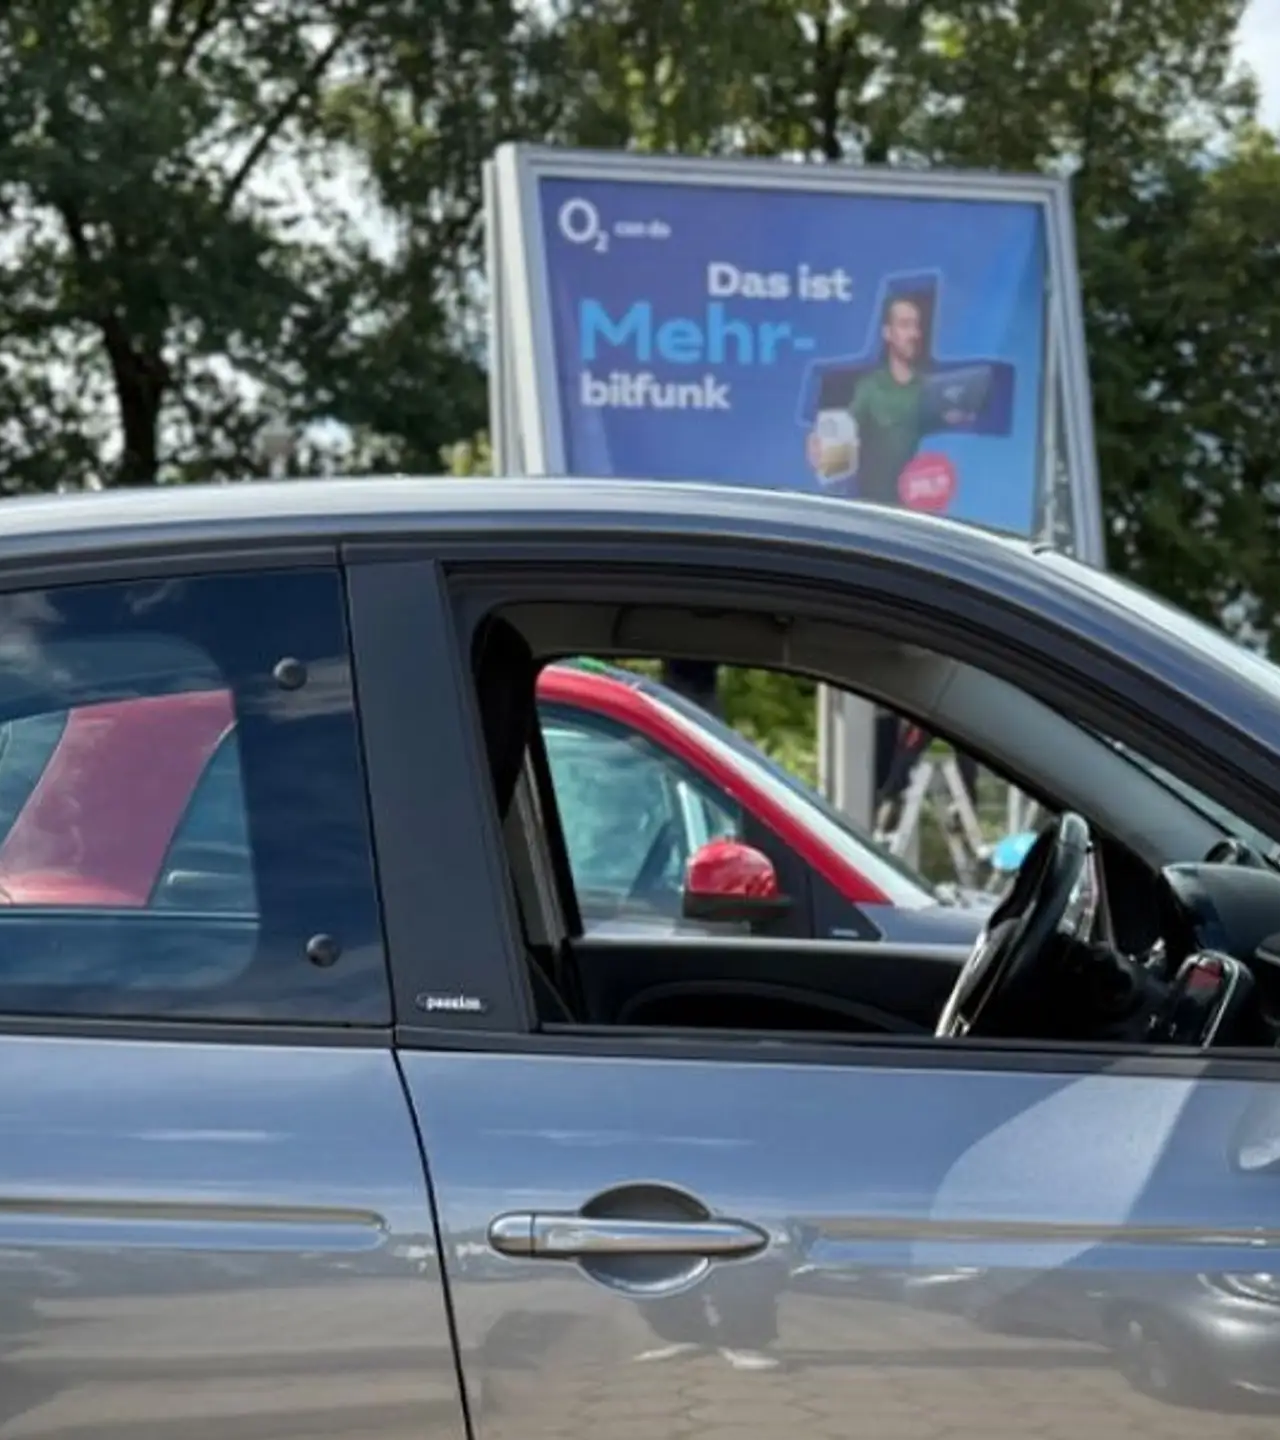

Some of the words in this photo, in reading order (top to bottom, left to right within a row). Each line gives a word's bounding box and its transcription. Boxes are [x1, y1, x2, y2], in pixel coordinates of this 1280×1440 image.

[708, 262, 789, 298] Das
[800, 263, 851, 302] ist
[581, 299, 813, 363] Mehr-
[582, 370, 730, 410] bilfunk
